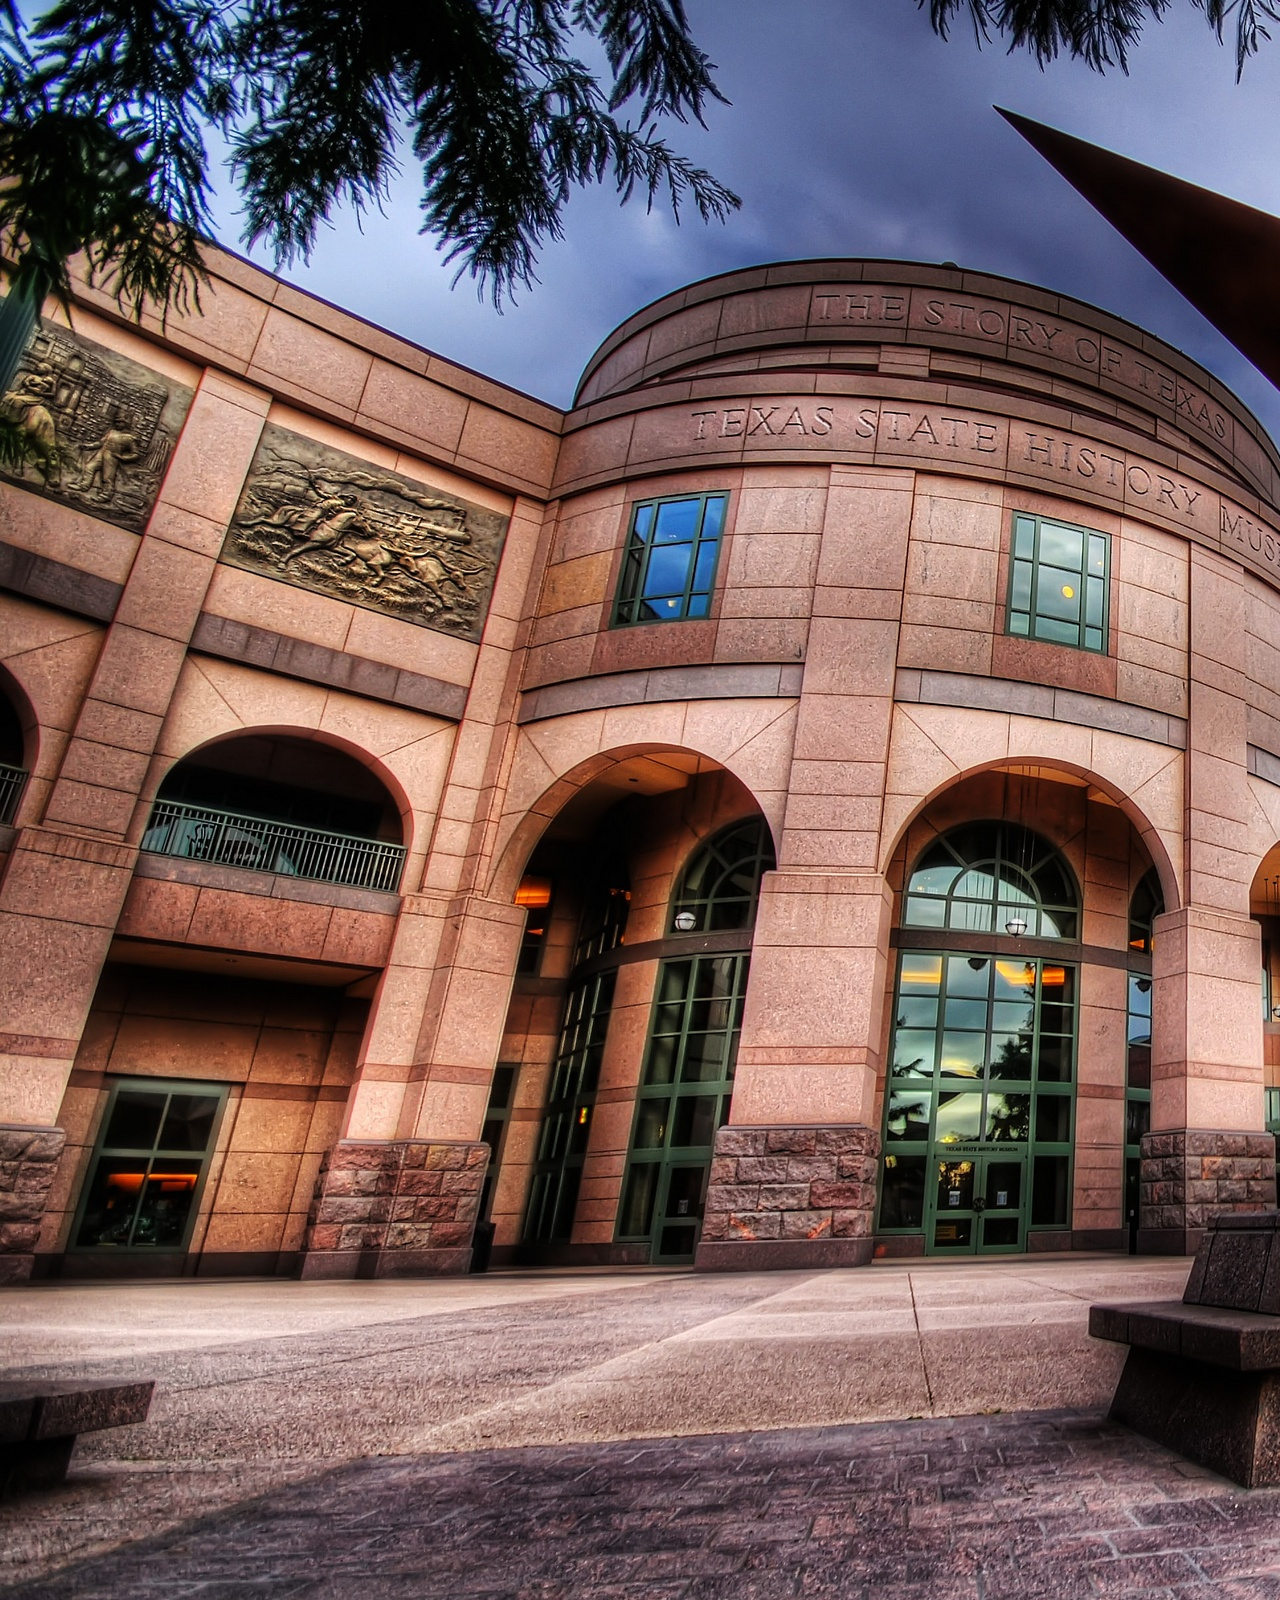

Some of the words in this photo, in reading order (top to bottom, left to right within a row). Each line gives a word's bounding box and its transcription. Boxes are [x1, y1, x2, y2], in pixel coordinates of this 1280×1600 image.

[815, 294, 905, 321] THE
[923, 299, 1062, 351] STORY
[1074, 337, 1123, 373] OF
[1134, 359, 1227, 439] TEXAS
[691, 406, 835, 441] TEXAS
[854, 408, 999, 453] STATE
[1023, 431, 1202, 518] HISTORY
